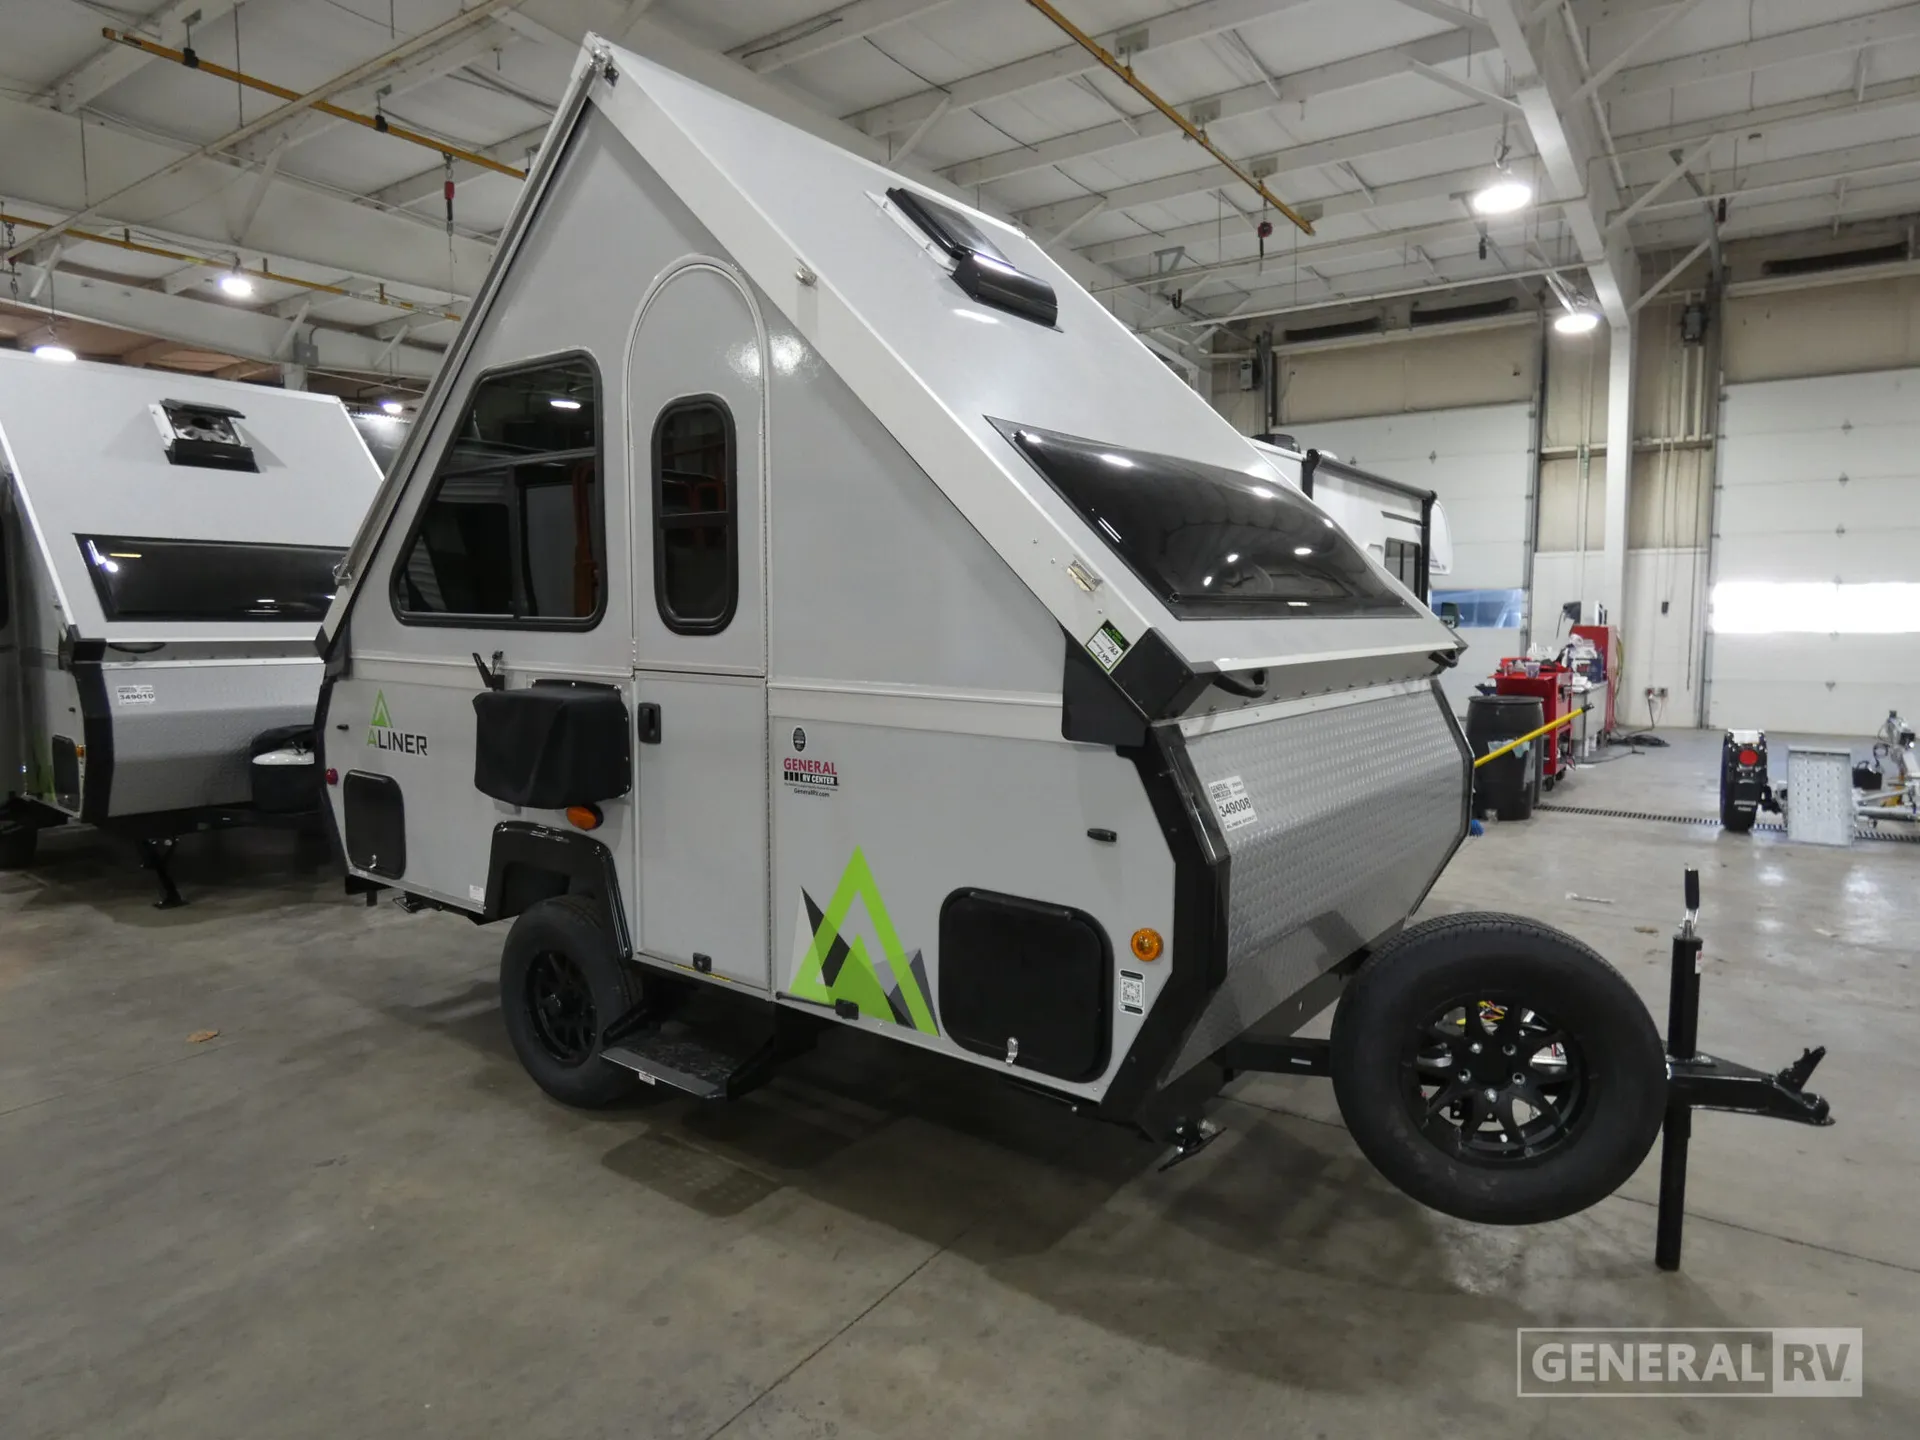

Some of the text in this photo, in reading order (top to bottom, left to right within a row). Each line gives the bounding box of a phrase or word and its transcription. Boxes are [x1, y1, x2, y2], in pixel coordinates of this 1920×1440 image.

[367, 728, 428, 756] ALINER
[784, 758, 838, 775] GENERAL
[802, 773, 835, 785] RV CENTER
[1219, 797, 1252, 817] 349008
